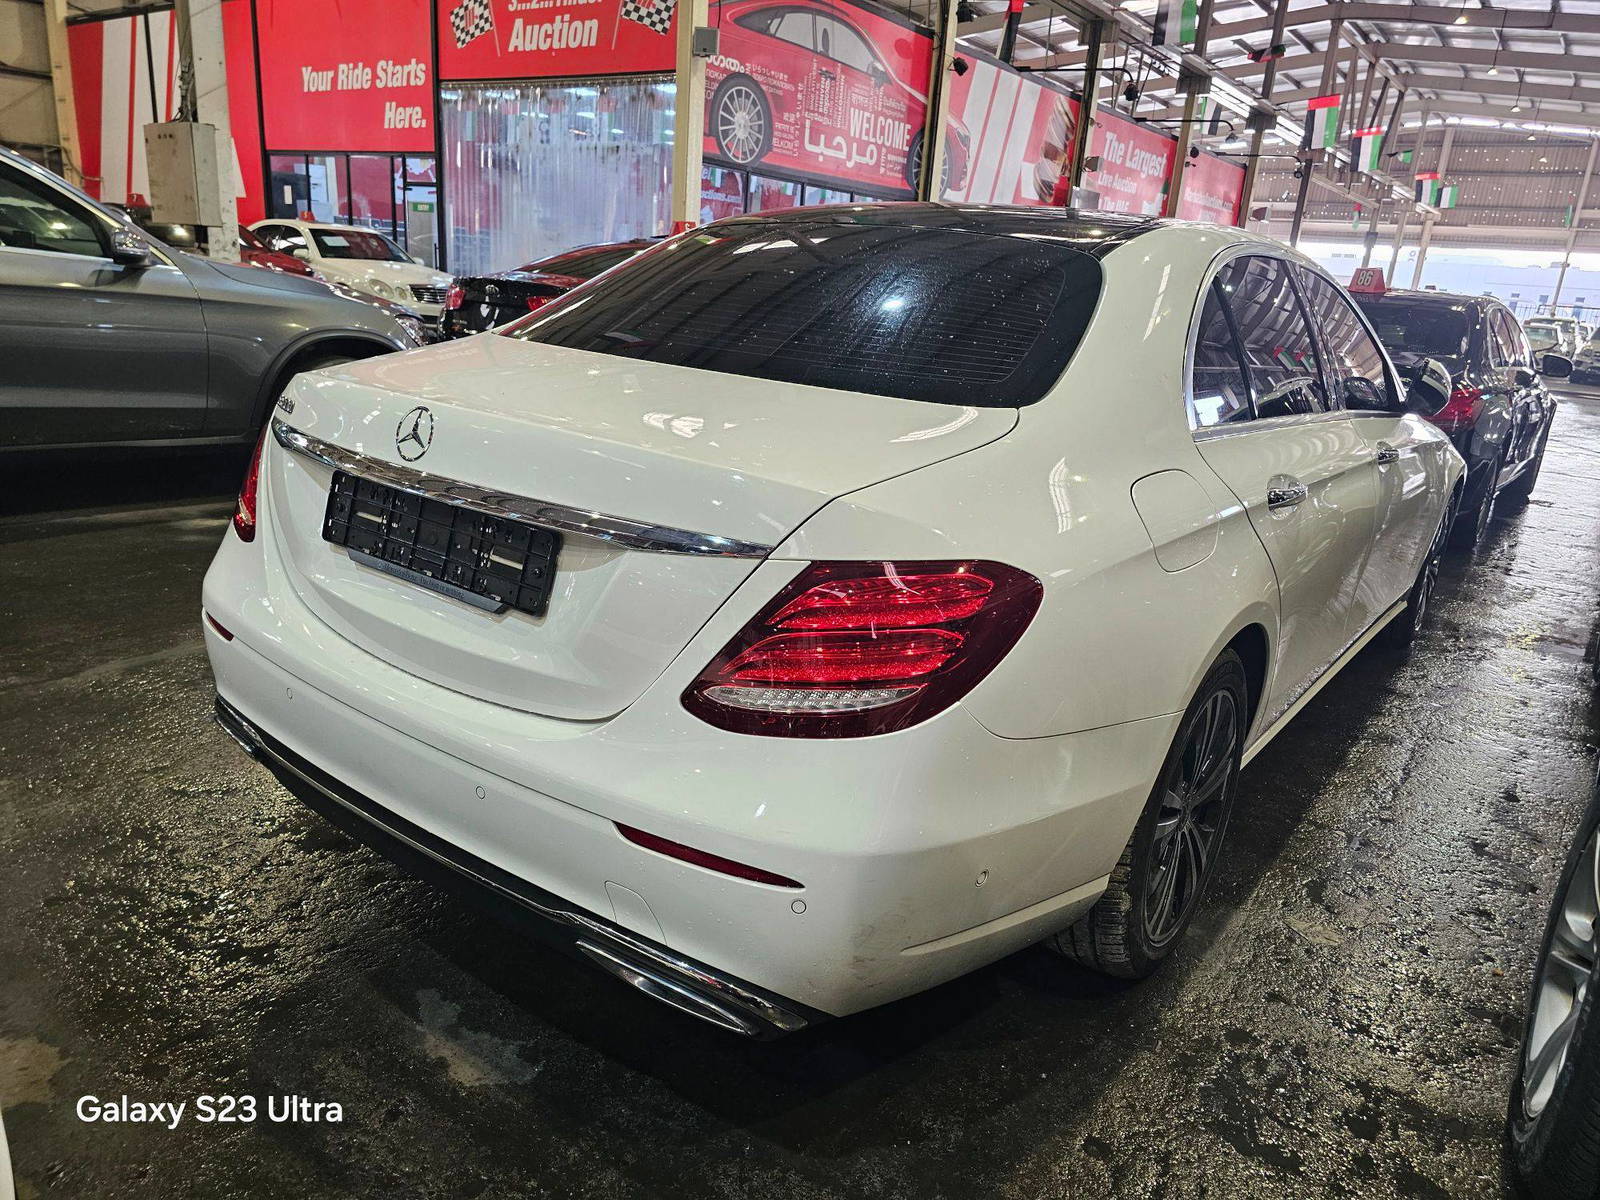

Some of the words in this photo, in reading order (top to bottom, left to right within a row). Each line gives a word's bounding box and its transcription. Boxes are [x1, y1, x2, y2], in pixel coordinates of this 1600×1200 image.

[508, 14, 599, 52] Auction
[302, 66, 334, 93] Your
[337, 62, 372, 90] Ride
[376, 59, 426, 89] Starts
[384, 101, 427, 129] Here.
[850, 107, 912, 152] WELCOME
[804, 119, 877, 169] مرحبا
[1104, 131, 1125, 165] The
[1125, 140, 1167, 179] Largest
[1098, 171, 1114, 189] Live
[1357, 270, 1374, 286] 86
